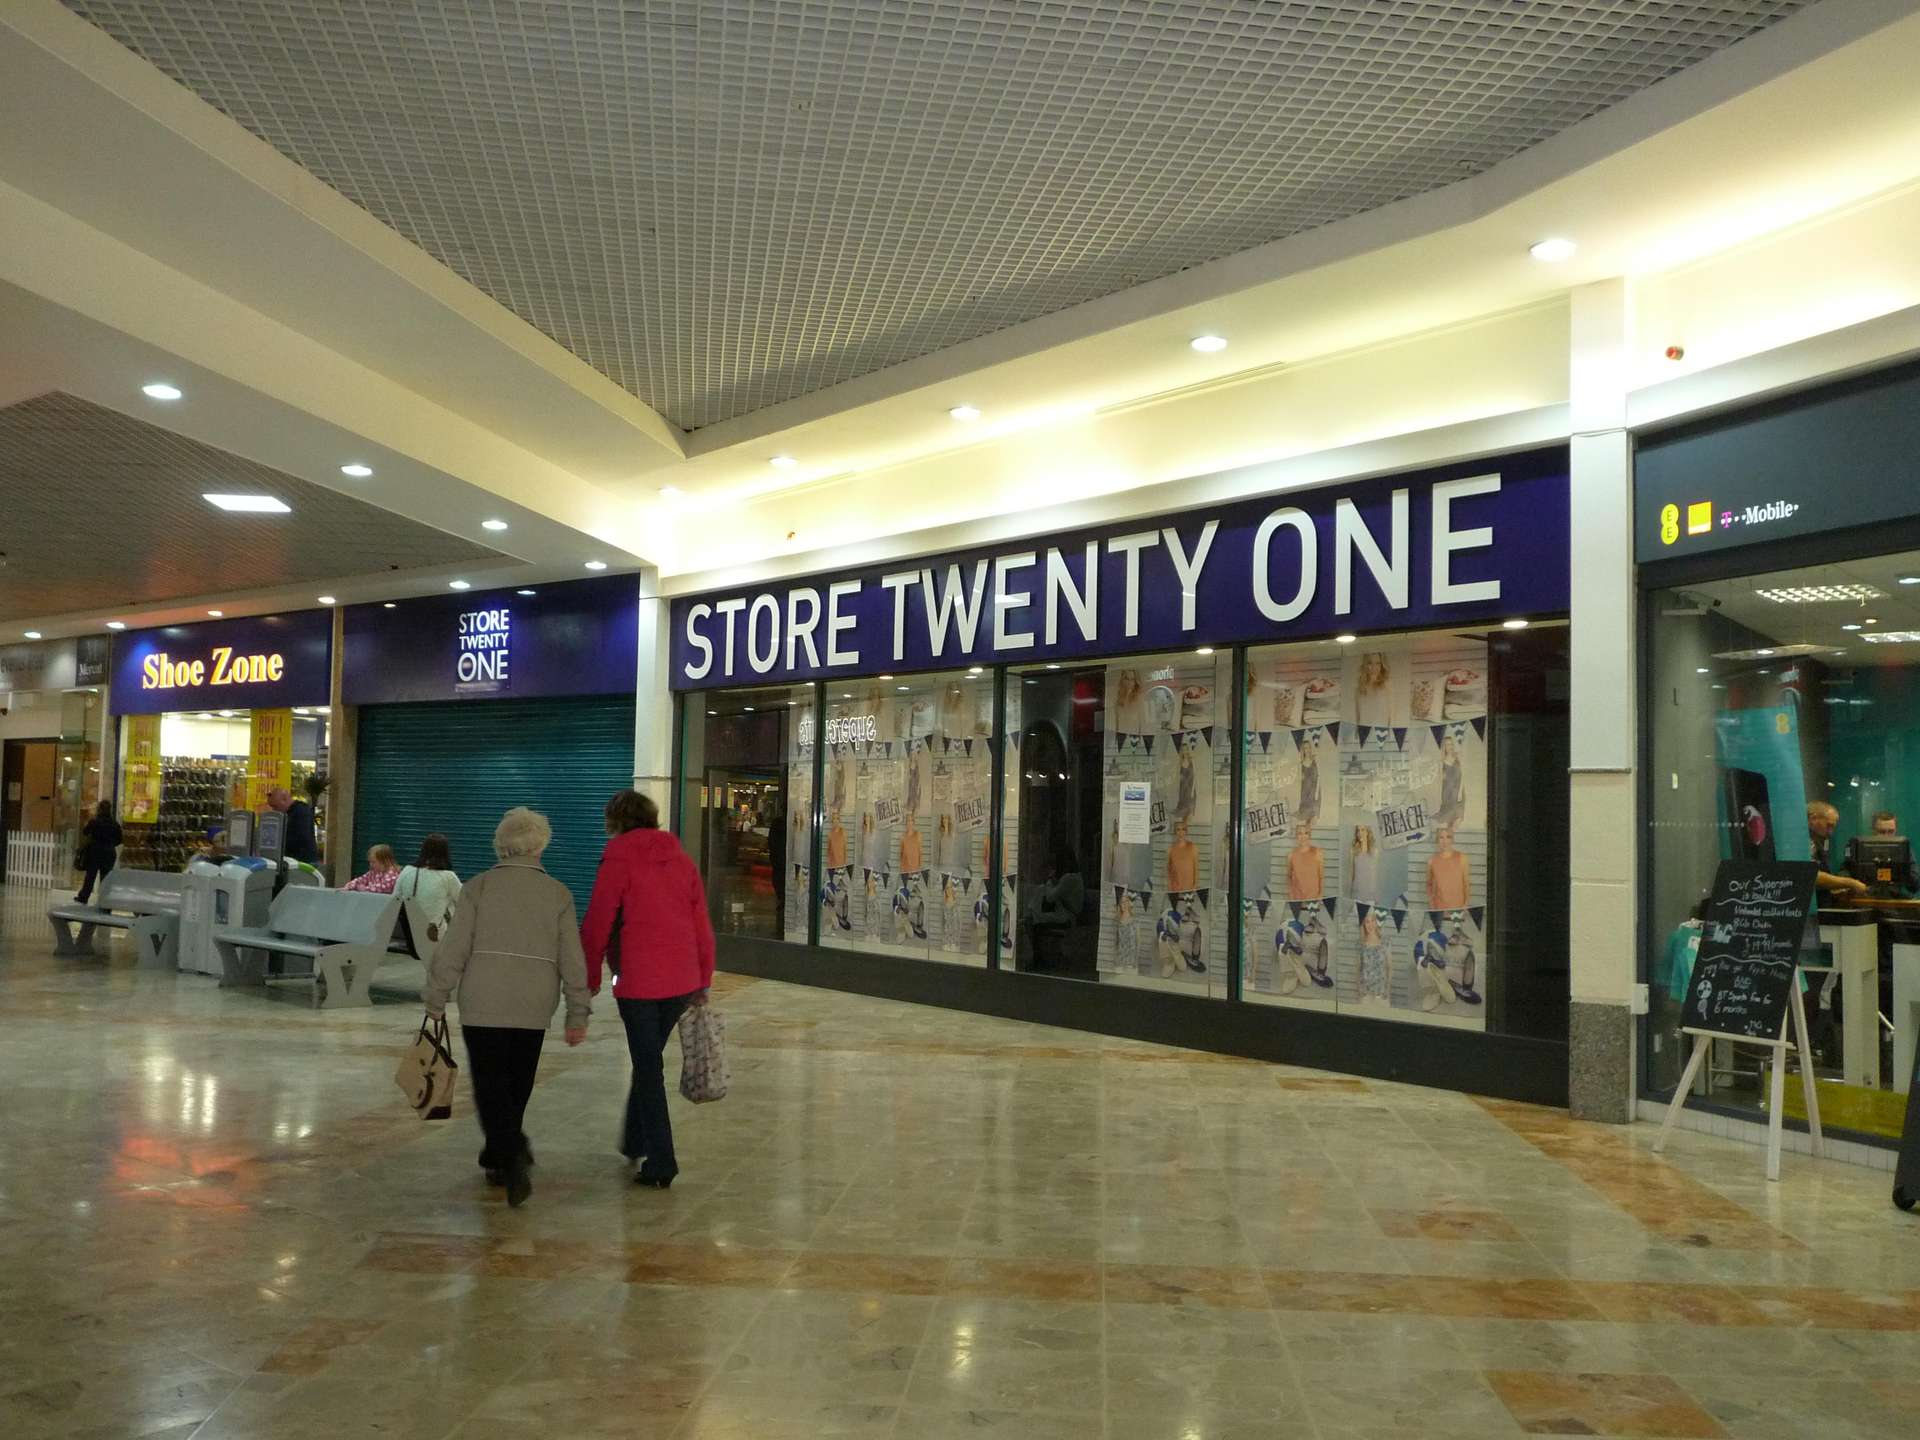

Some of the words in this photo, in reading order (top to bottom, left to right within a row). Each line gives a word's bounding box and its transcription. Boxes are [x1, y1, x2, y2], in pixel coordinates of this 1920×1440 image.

[684, 579, 862, 681] STORE
[881, 518, 1220, 662] TWENTY
[1251, 472, 1502, 622] ONE
[458, 608, 510, 634] STORE
[458, 632, 509, 651] TWENTY
[142, 650, 205, 690] Shoe
[210, 646, 284, 686] Zone
[457, 650, 509, 683] ONE
[257, 737, 274, 756] GET
[1248, 803, 1288, 833] BEACH
[1381, 803, 1426, 837] BEACH
[1728, 880, 1751, 892] Our
